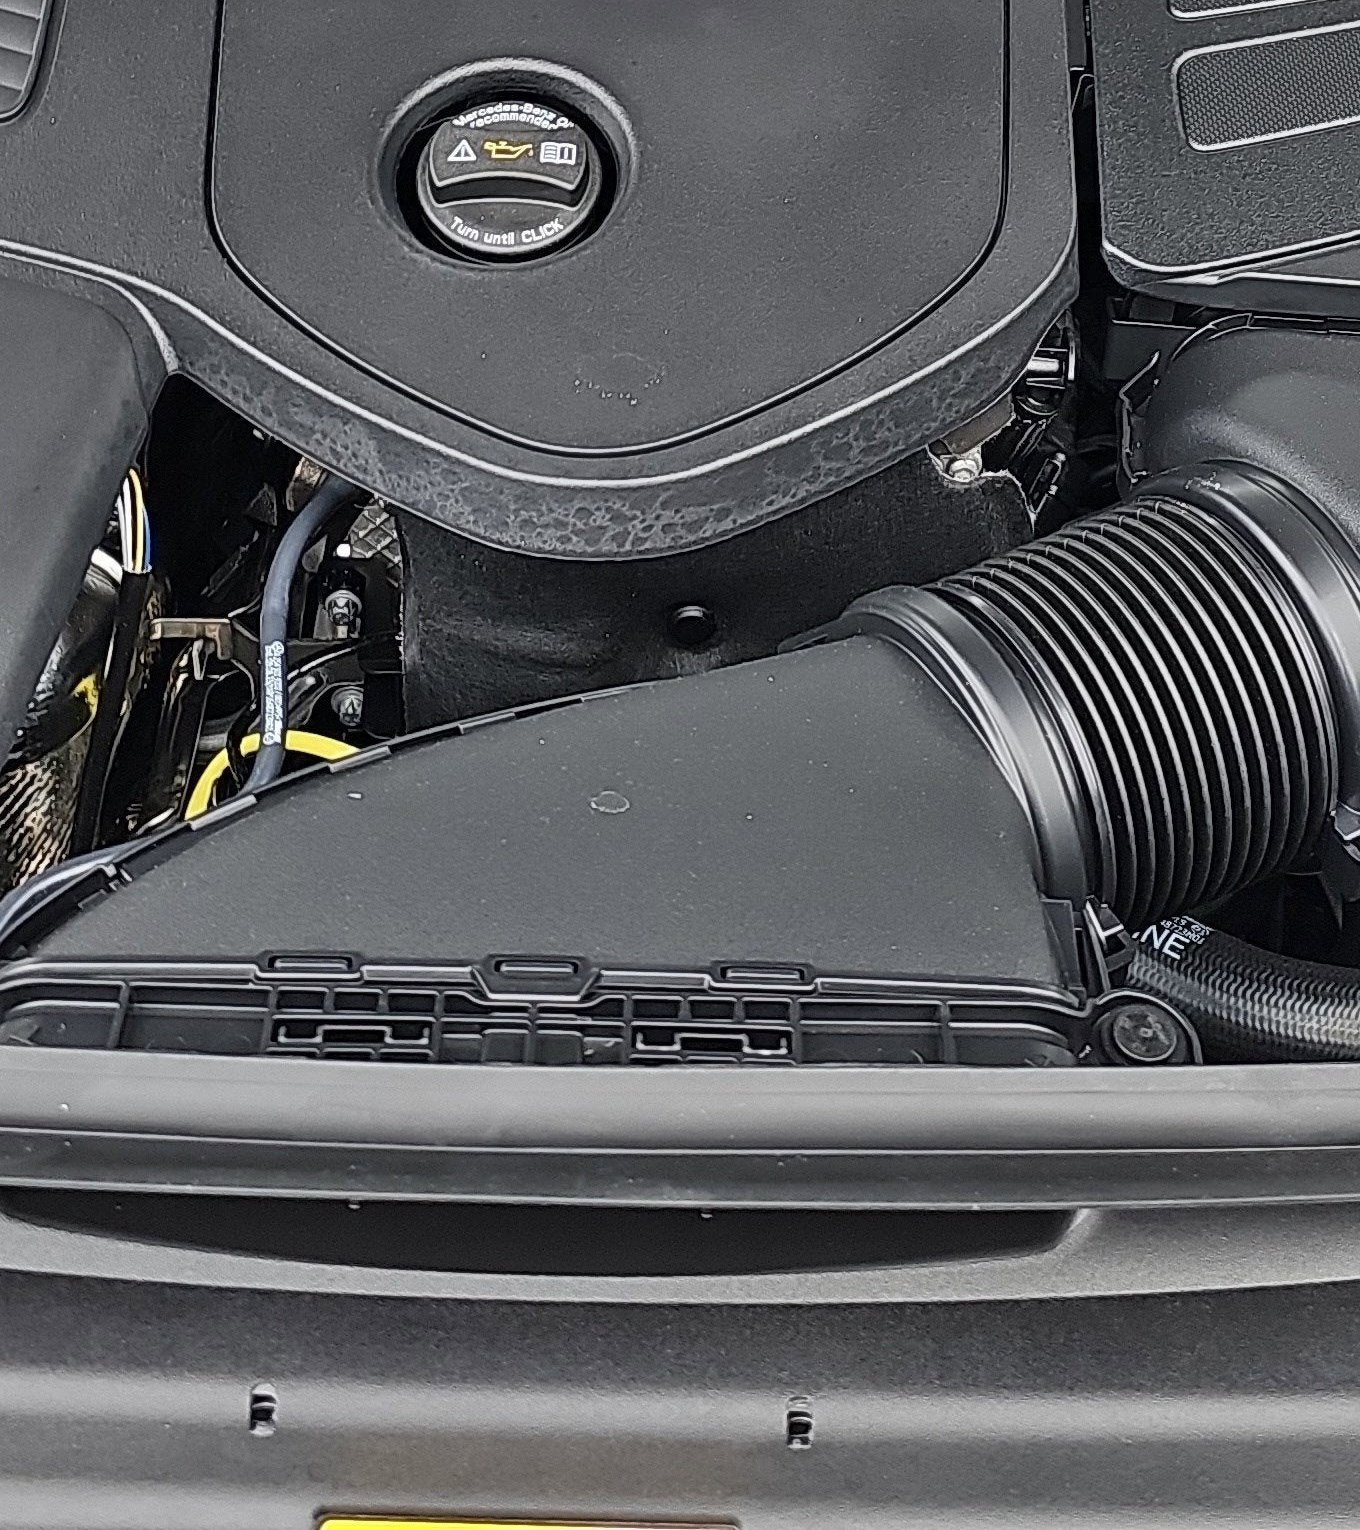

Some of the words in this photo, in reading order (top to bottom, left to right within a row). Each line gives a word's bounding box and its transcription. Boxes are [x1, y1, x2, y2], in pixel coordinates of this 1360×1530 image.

[449, 216, 480, 241] Turn
[484, 231, 515, 245] until
[521, 218, 564, 243] CLICK
[1132, 924, 1190, 960] NE
